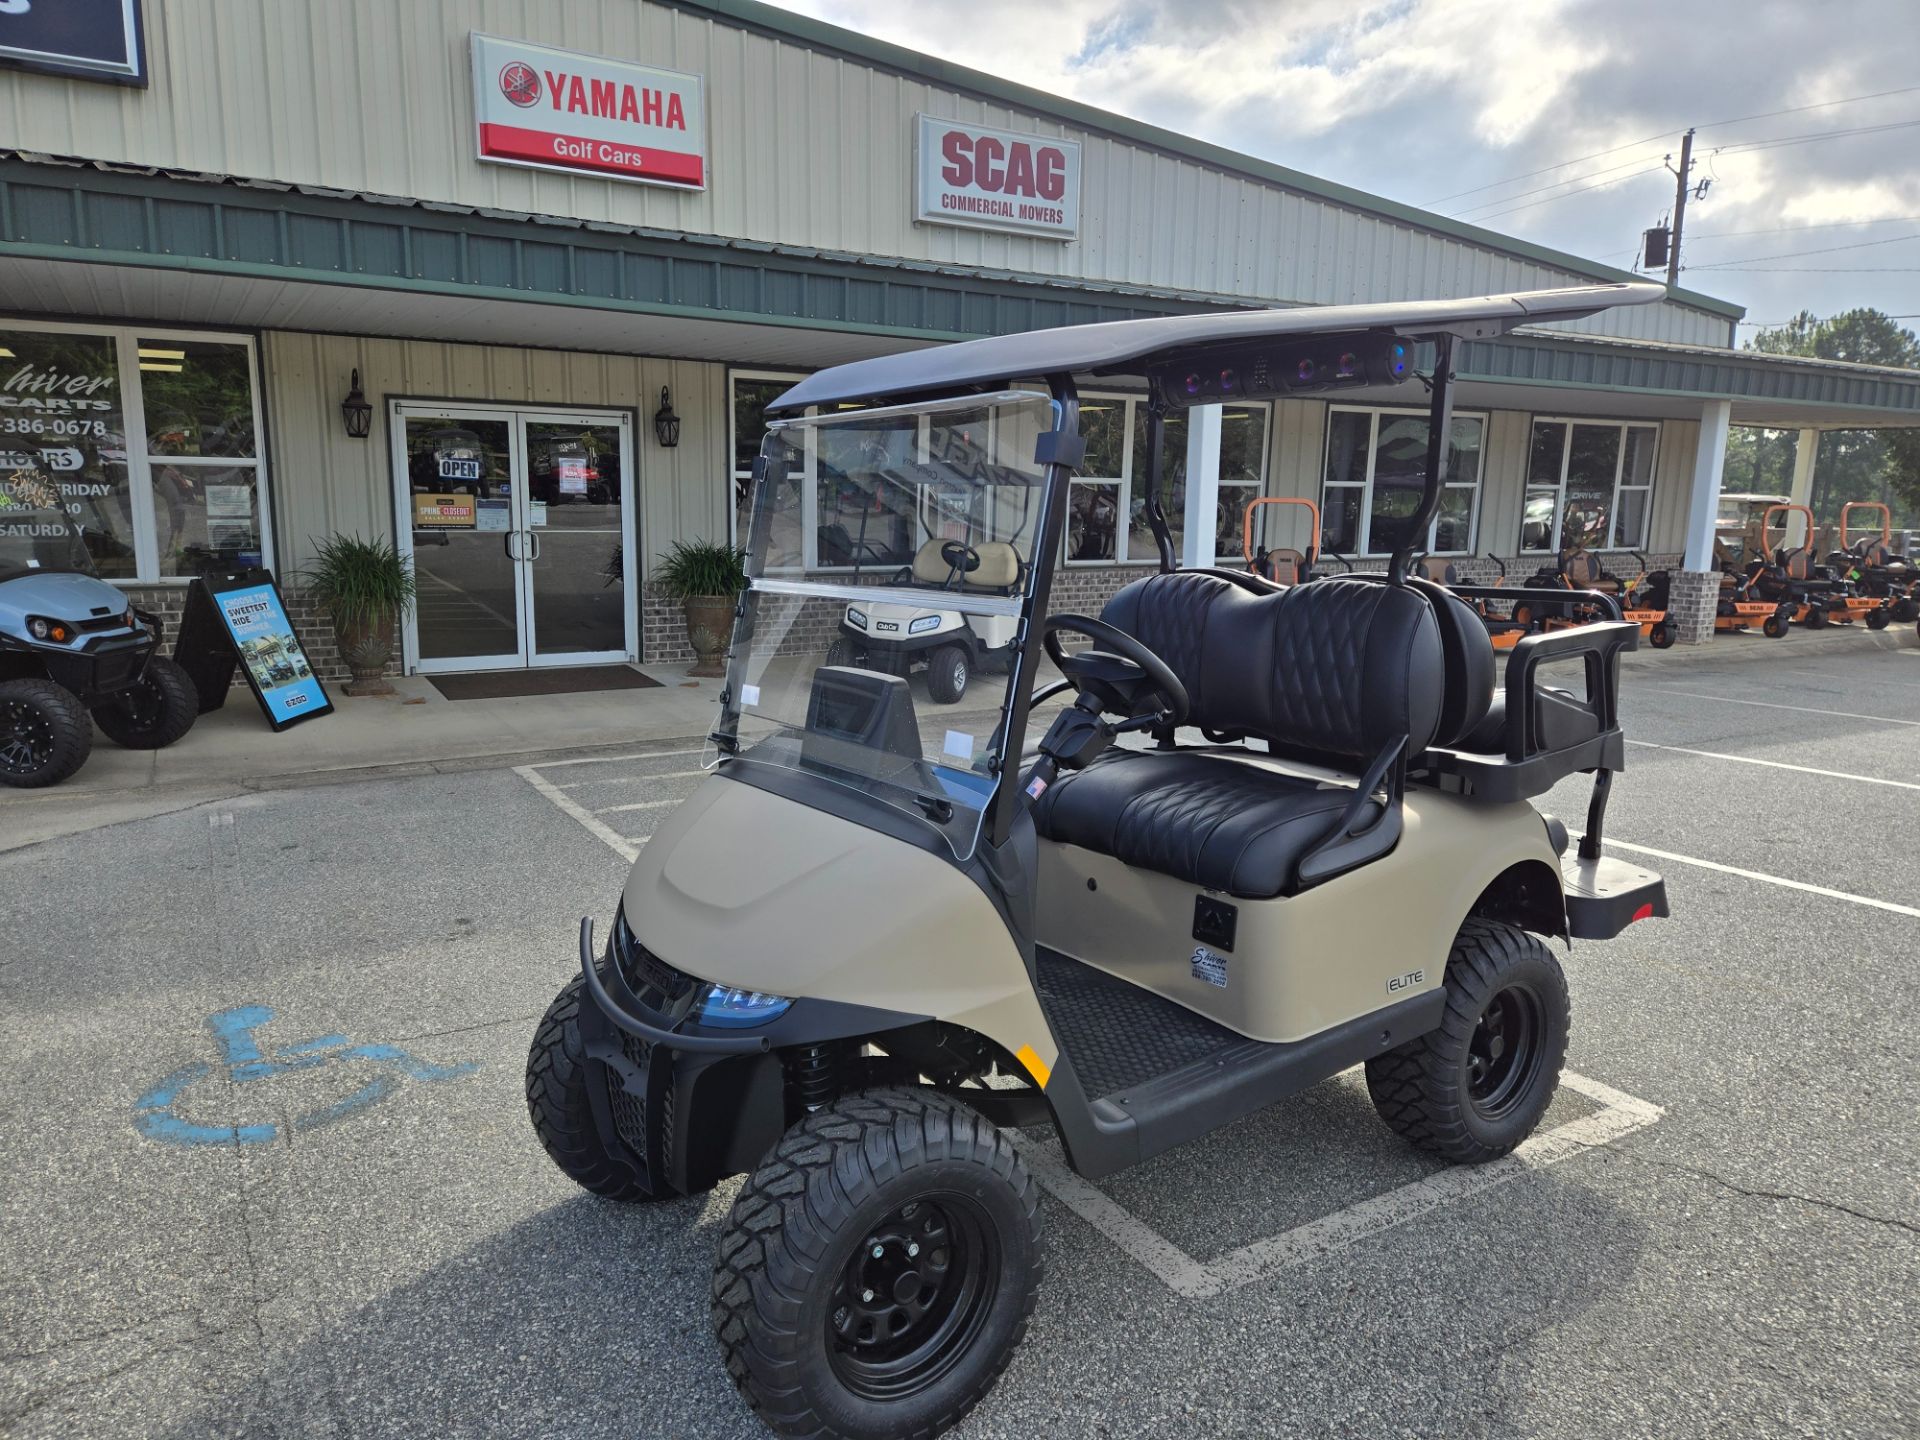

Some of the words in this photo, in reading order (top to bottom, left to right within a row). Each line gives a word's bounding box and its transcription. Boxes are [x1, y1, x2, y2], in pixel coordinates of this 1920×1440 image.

[544, 70, 686, 131] YAMAHA
[553, 137, 592, 160] Golf
[599, 144, 642, 167] Cars
[942, 130, 1065, 201] SCAG
[942, 192, 1014, 218] COMMERCIAL
[1019, 203, 1063, 224] MOWERS
[34, 408, 72, 416] LLC
[442, 461, 476, 477] OPEN
[1571, 491, 1602, 500] DRIVE
[420, 506, 441, 515] SPRING
[443, 507, 470, 515] CLOSEOUT
[227, 602, 268, 617] SWEETEST
[232, 616, 252, 626] RIDE
[1191, 948, 1227, 965] Shiver
[1389, 970, 1423, 991] ELITE
